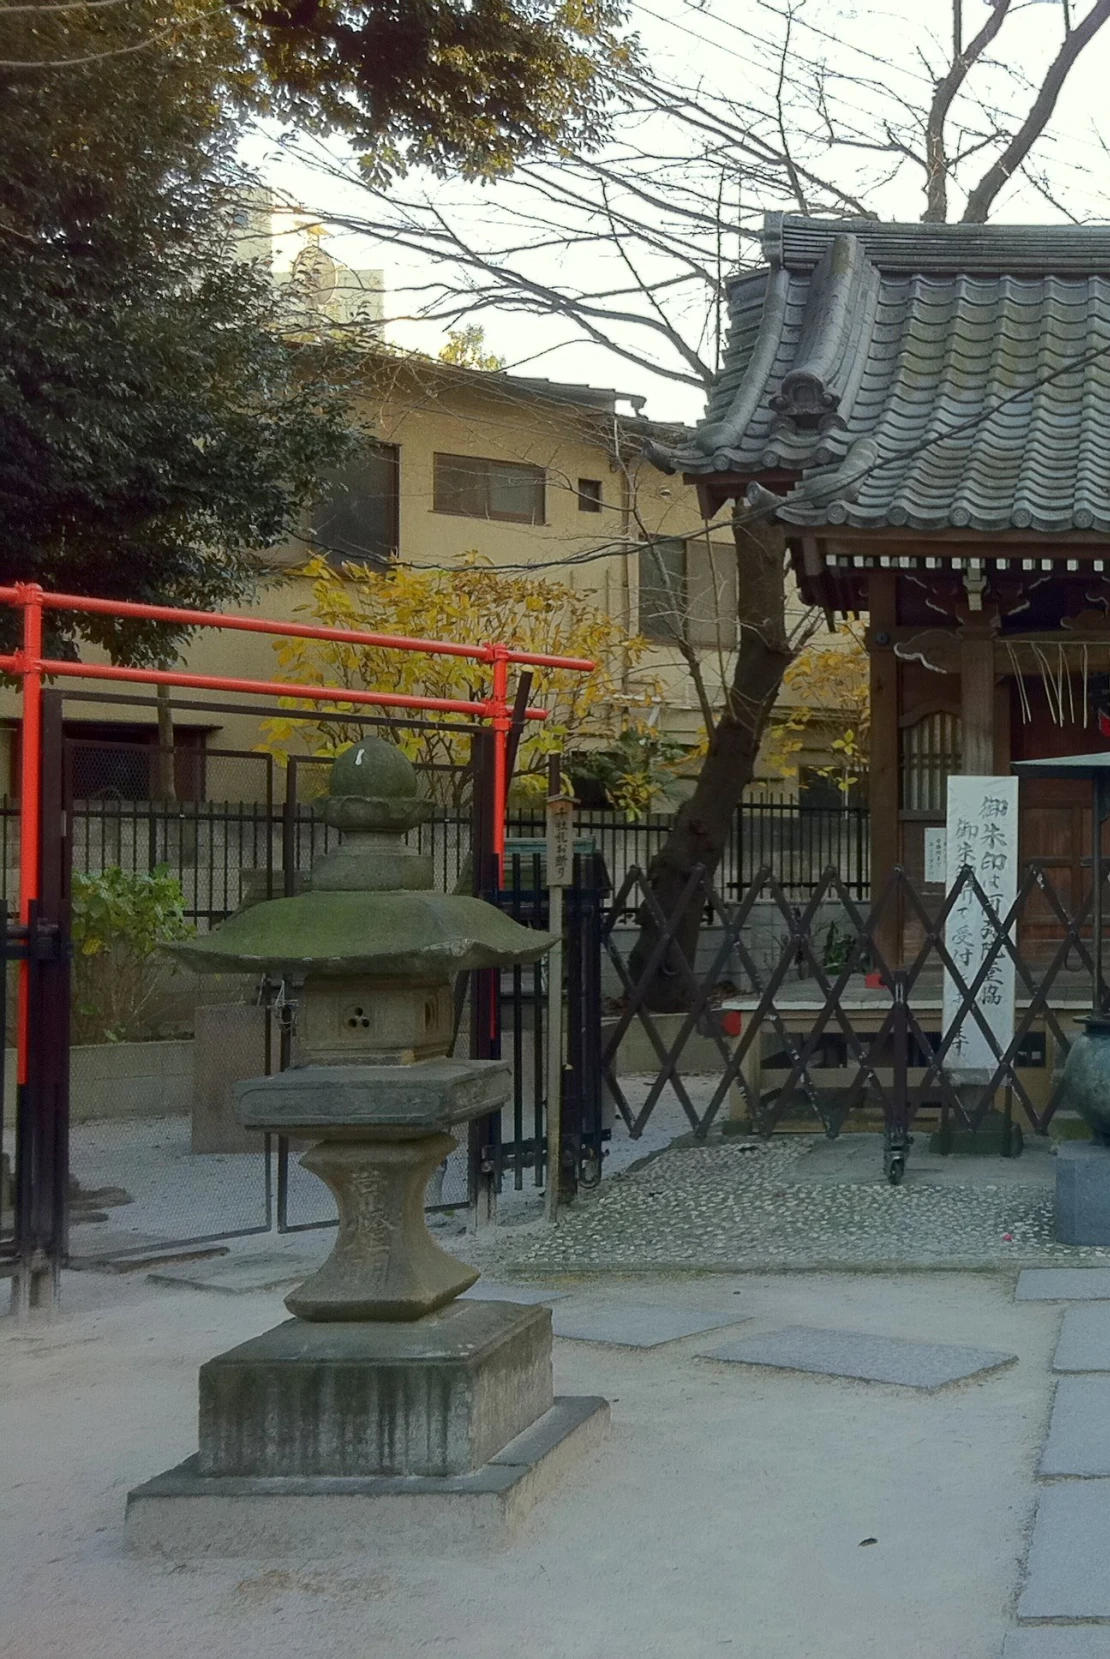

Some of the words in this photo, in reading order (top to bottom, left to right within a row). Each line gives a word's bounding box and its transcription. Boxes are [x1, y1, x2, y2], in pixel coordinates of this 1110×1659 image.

[555, 807, 568, 880] 千社札お断り
